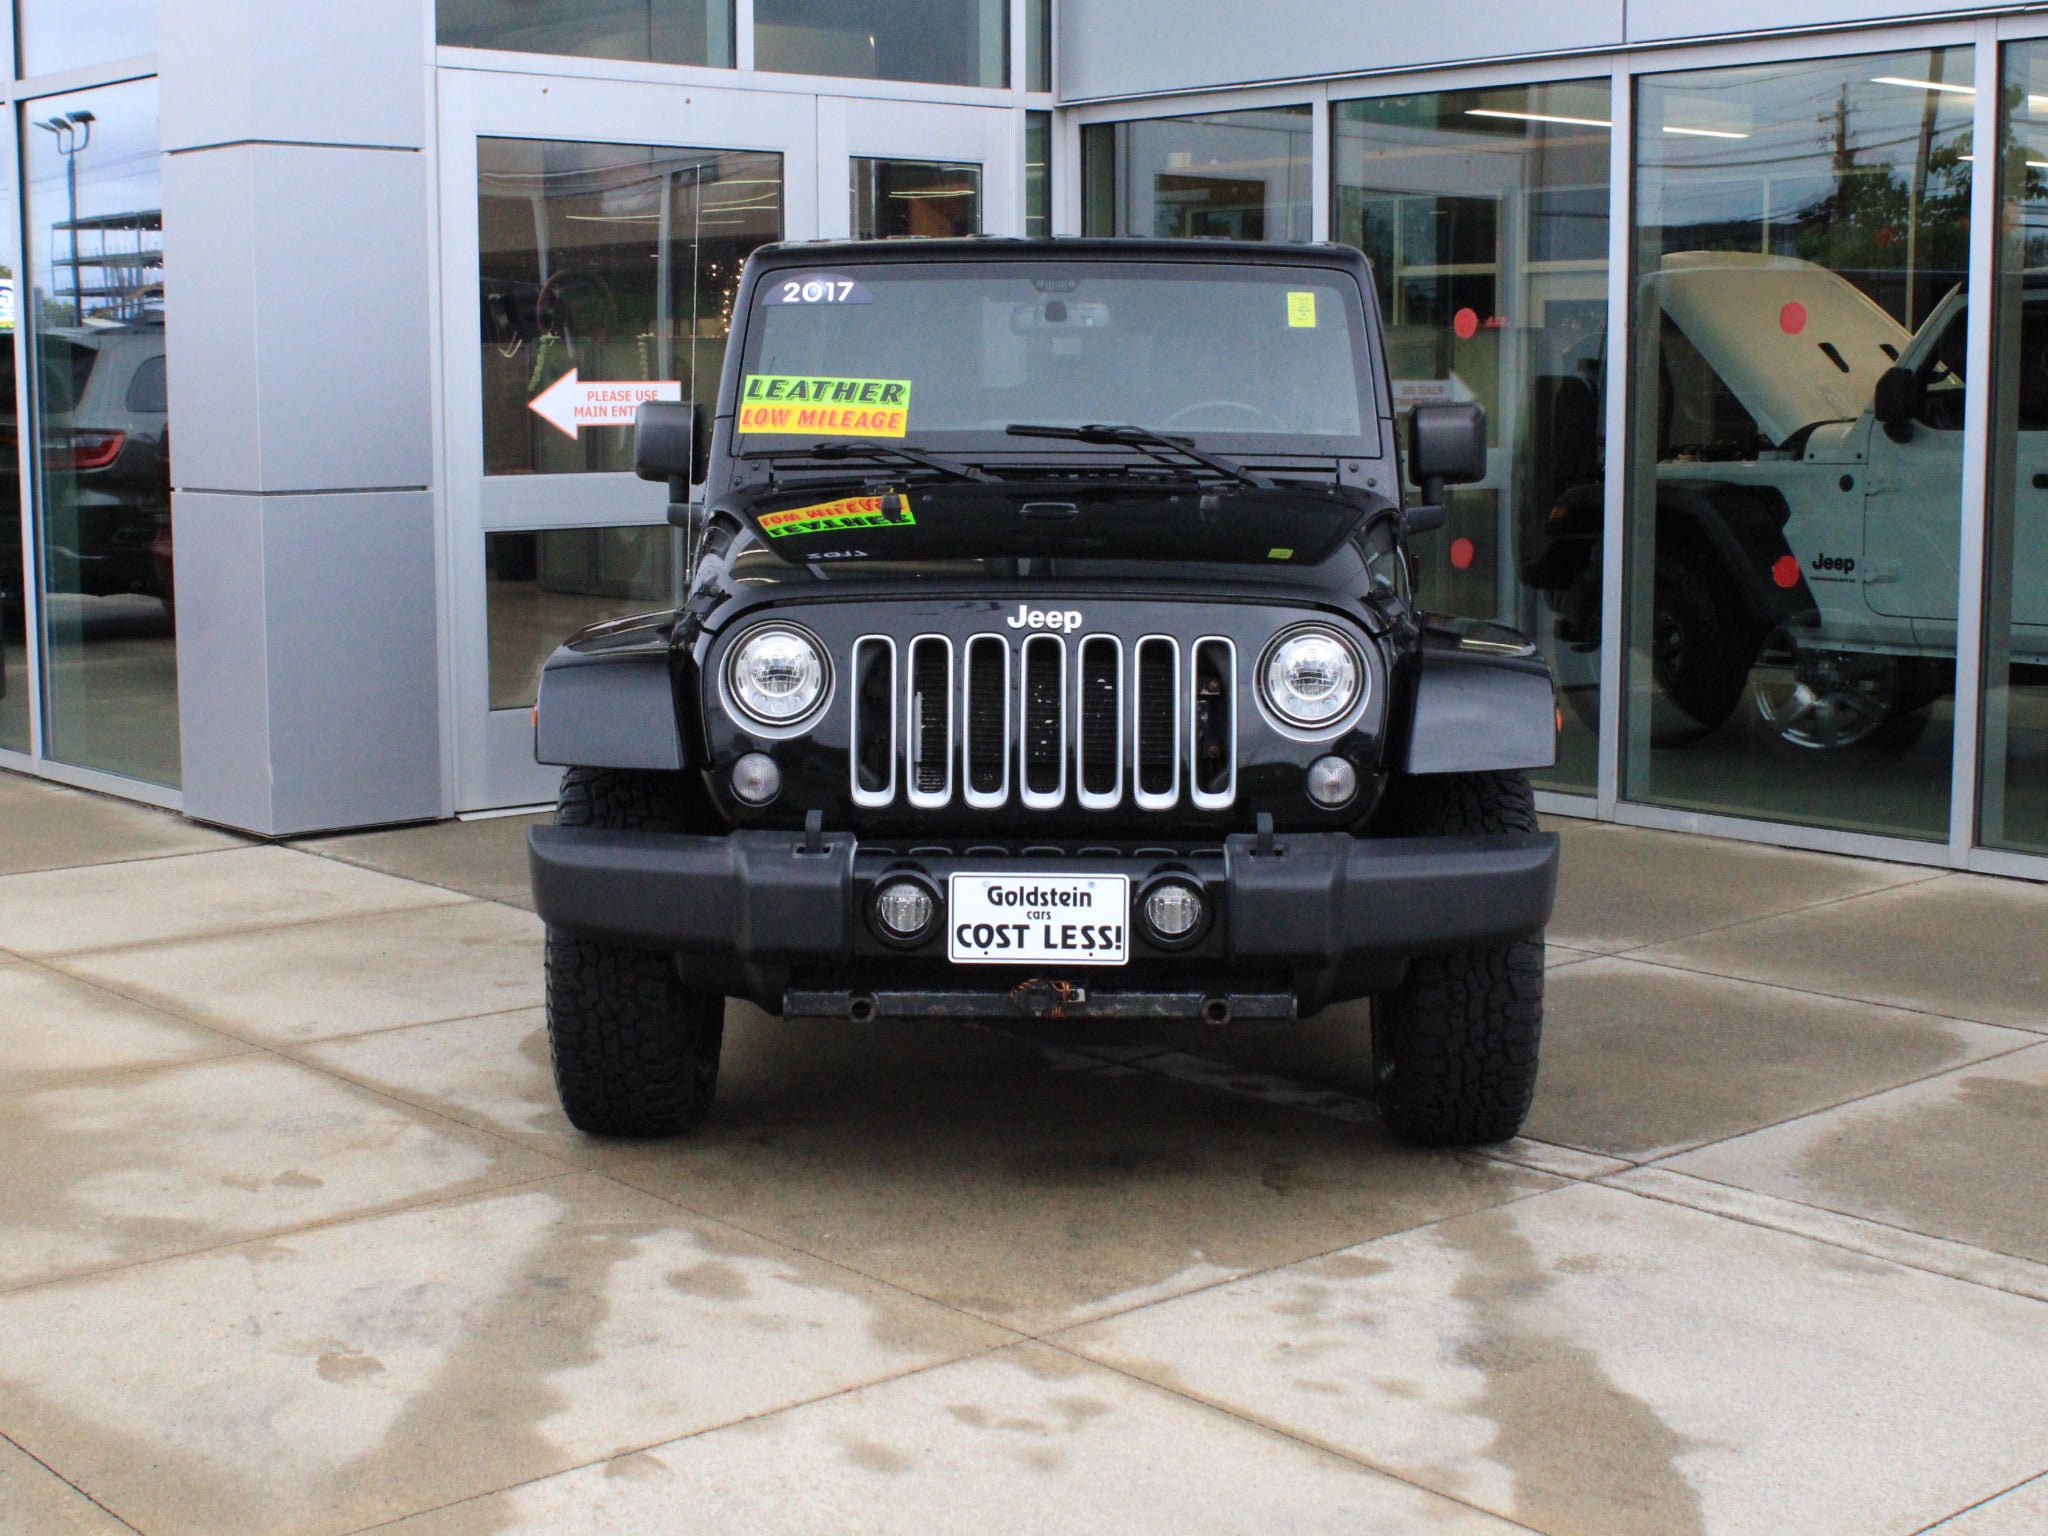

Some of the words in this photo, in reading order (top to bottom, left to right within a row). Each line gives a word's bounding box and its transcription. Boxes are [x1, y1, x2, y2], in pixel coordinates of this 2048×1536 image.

[782, 281, 854, 302] 2017
[587, 390, 632, 402] PLEASE
[635, 390, 659, 401] USE
[746, 378, 906, 404] LEATHER
[574, 406, 608, 418] MAIN
[741, 408, 791, 427] LOW
[797, 409, 902, 431] MILEAGE
[1811, 552, 1855, 575] Jeep
[1007, 604, 1083, 634] Jeep
[987, 885, 1092, 907] Goldstein
[1026, 910, 1052, 920] cars
[956, 923, 1031, 949] COST
[1044, 924, 1122, 950] LESS!
